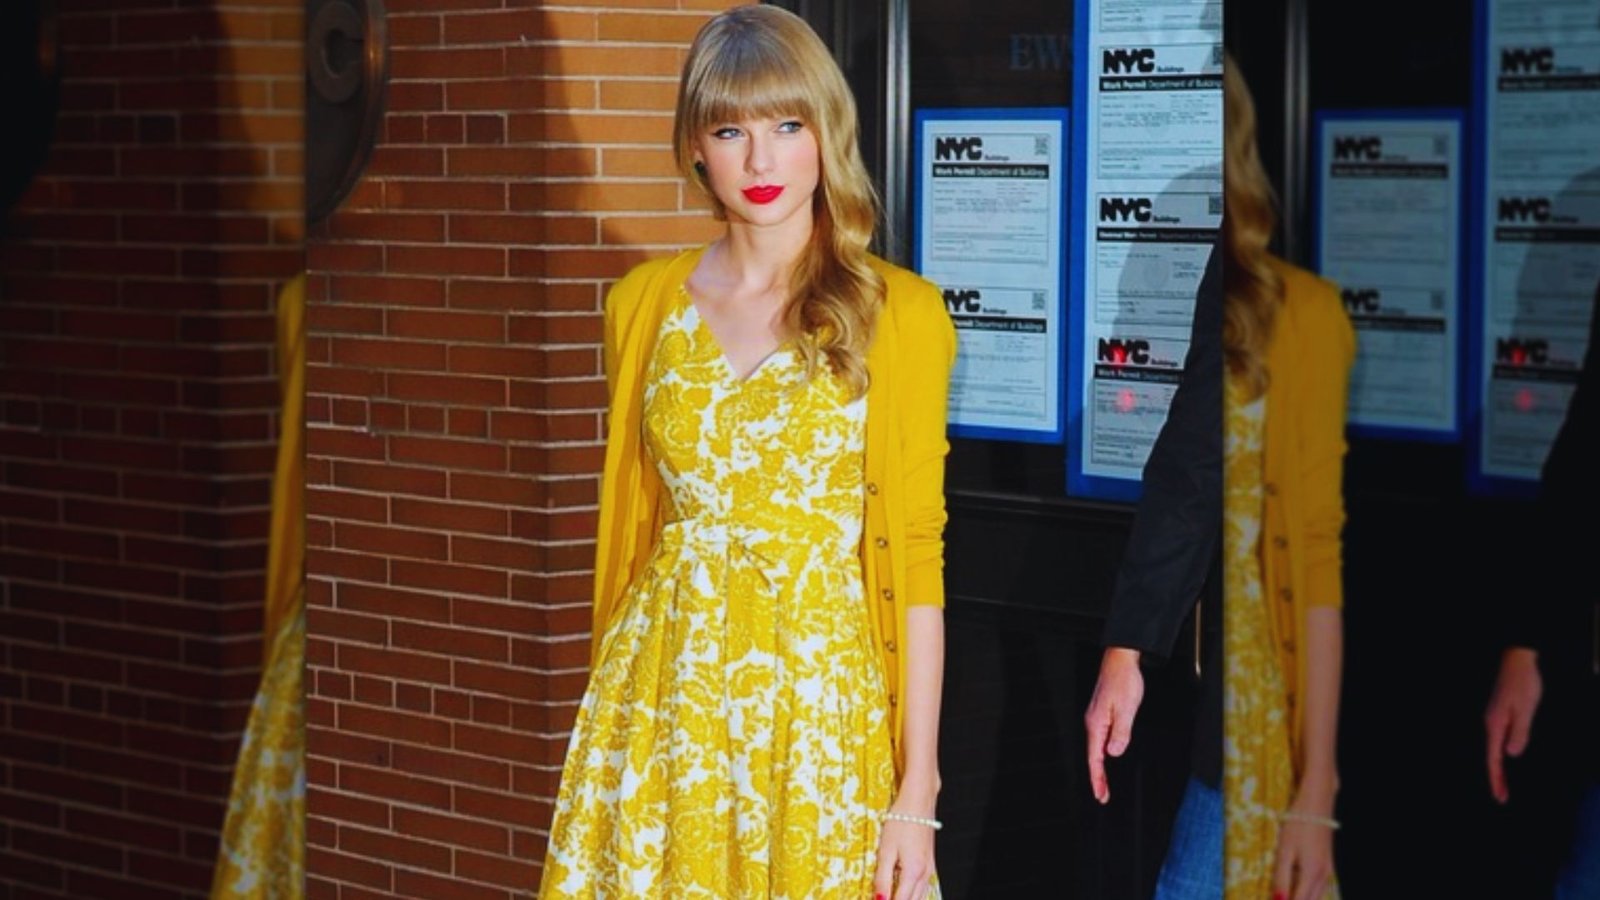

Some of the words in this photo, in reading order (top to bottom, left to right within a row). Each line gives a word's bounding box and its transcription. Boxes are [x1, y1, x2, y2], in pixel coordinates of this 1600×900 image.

[1103, 48, 1154, 73] NYC
[1501, 47, 1553, 73] NYC
[1103, 81, 1121, 89] Work
[1123, 80, 1146, 89] Permit
[1149, 80, 1185, 90] Department
[935, 136, 982, 161] NYC
[1333, 136, 1381, 160] NYC
[935, 167, 952, 175] Work
[953, 167, 976, 175] Permit
[977, 168, 1010, 177] Department
[1019, 168, 1046, 178] Buildings
[1099, 197, 1152, 222] NYC
[1498, 197, 1551, 222] NYC
[1098, 338, 1150, 365] NYC
